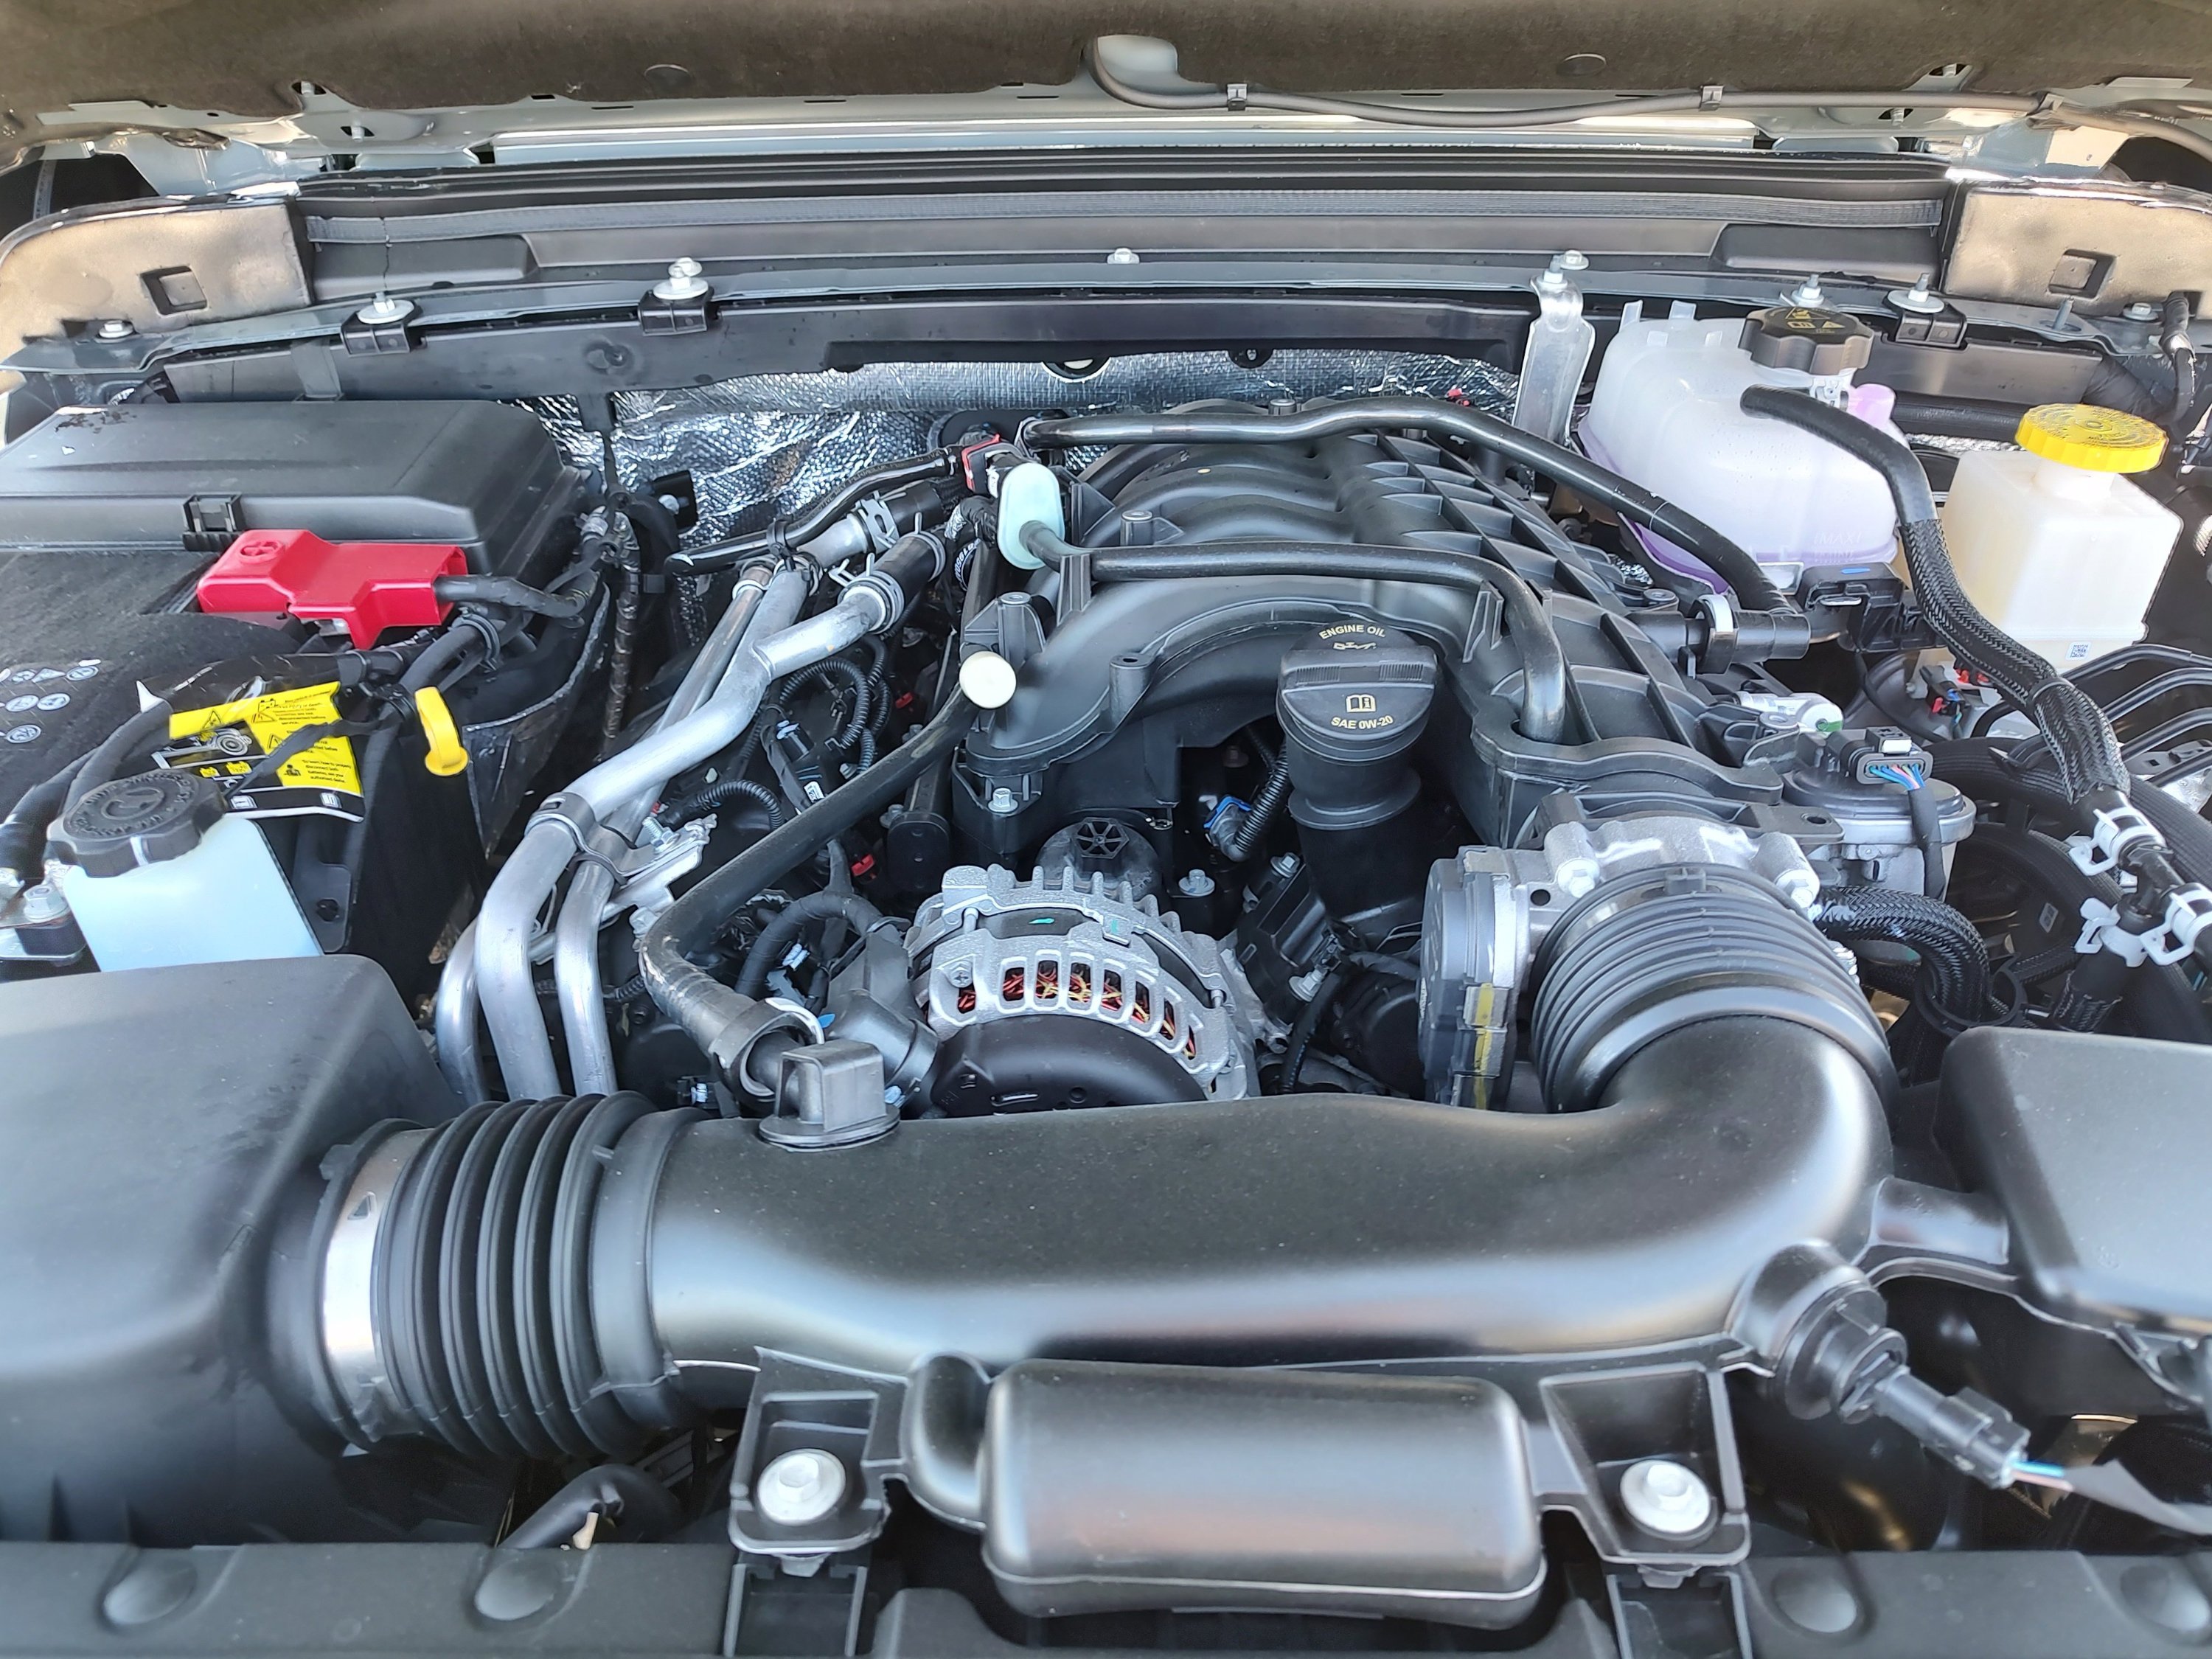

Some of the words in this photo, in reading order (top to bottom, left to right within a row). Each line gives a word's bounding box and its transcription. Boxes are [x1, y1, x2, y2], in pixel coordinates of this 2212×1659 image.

[1318, 625, 1365, 639] ENGINE
[1367, 626, 1386, 638] OIL
[1331, 717, 1357, 729] SAE
[1358, 715, 1394, 729] 0W-20
